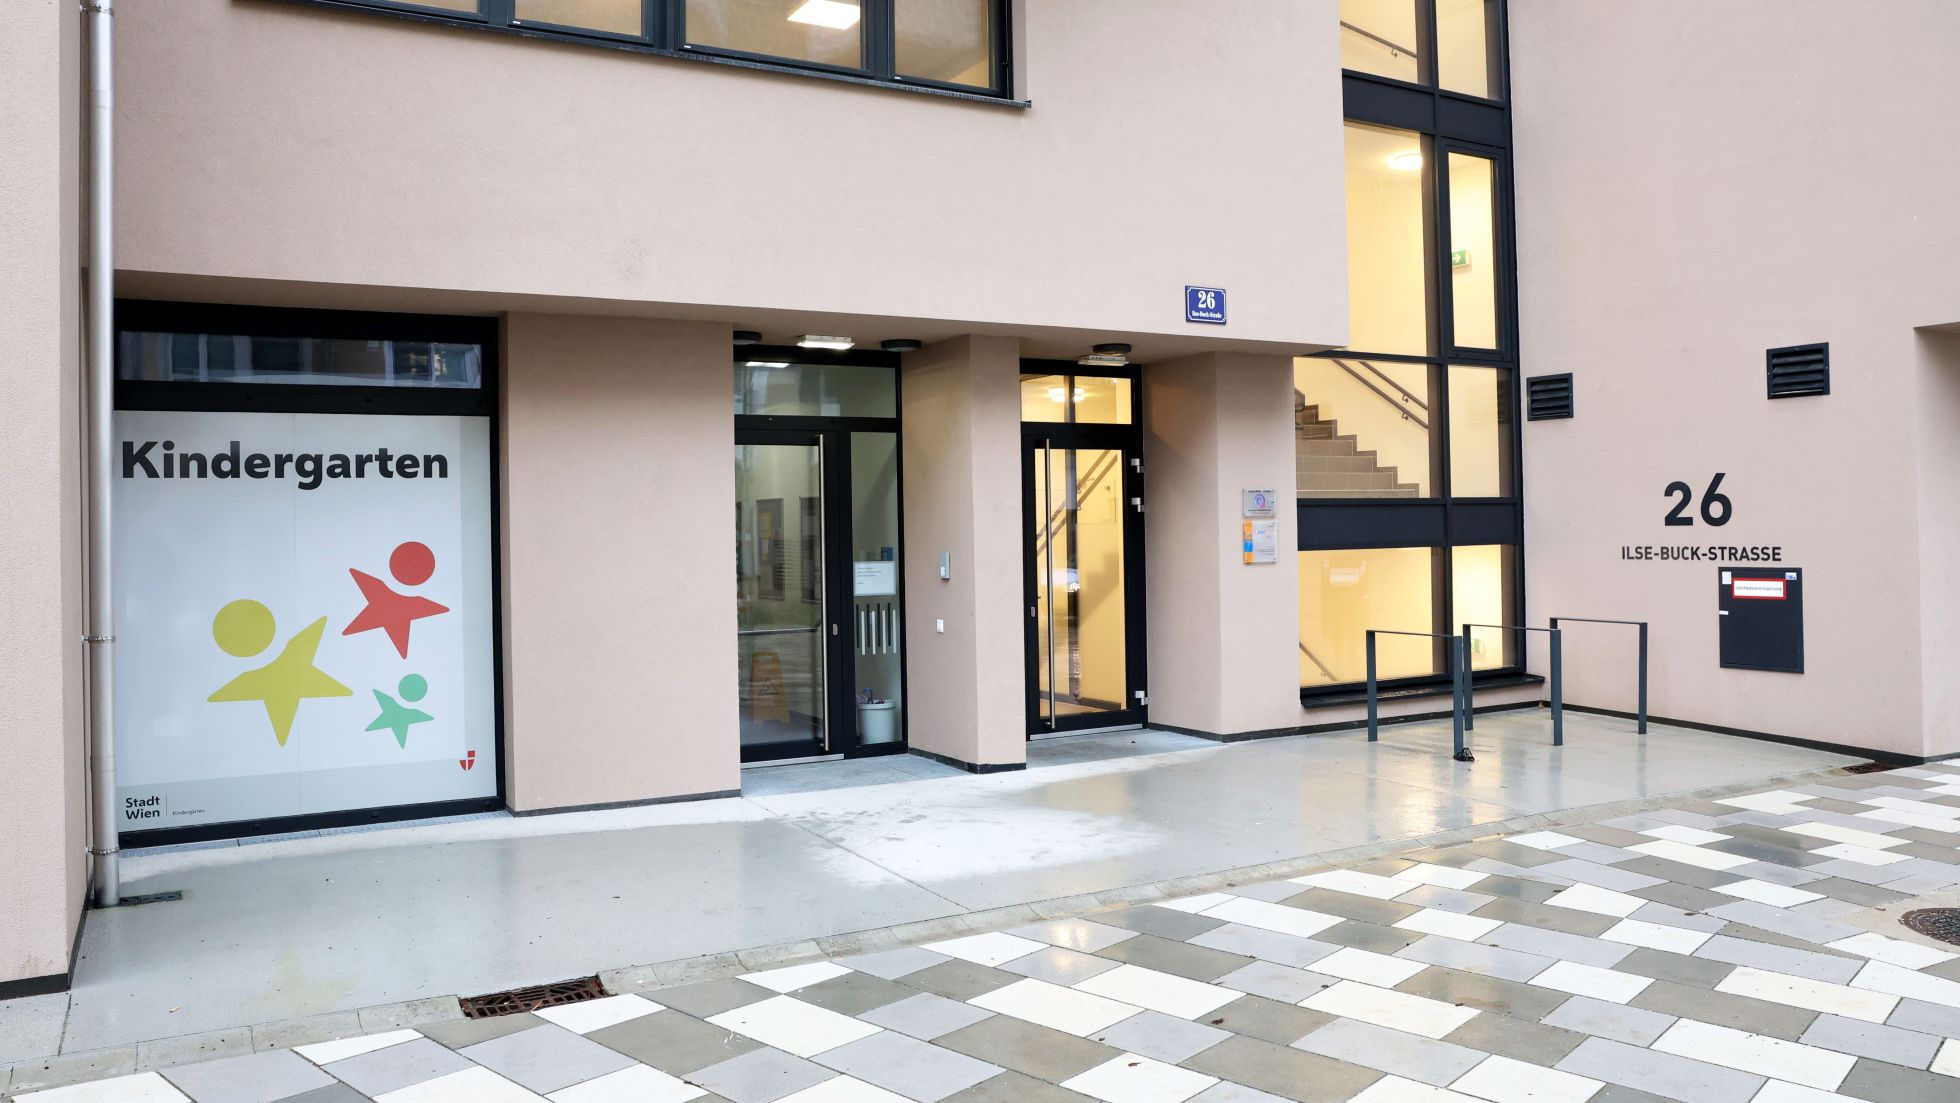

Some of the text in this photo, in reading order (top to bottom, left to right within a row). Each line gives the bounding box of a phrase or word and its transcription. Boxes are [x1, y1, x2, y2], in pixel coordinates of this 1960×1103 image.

[1198, 290, 1216, 309] 26
[122, 440, 448, 490] Kindergarten
[1664, 473, 1732, 526] 26
[1622, 546, 1782, 561] ILSE-BUCK-STRASSE
[125, 796, 160, 808] Stadt
[125, 809, 160, 820] Wien
